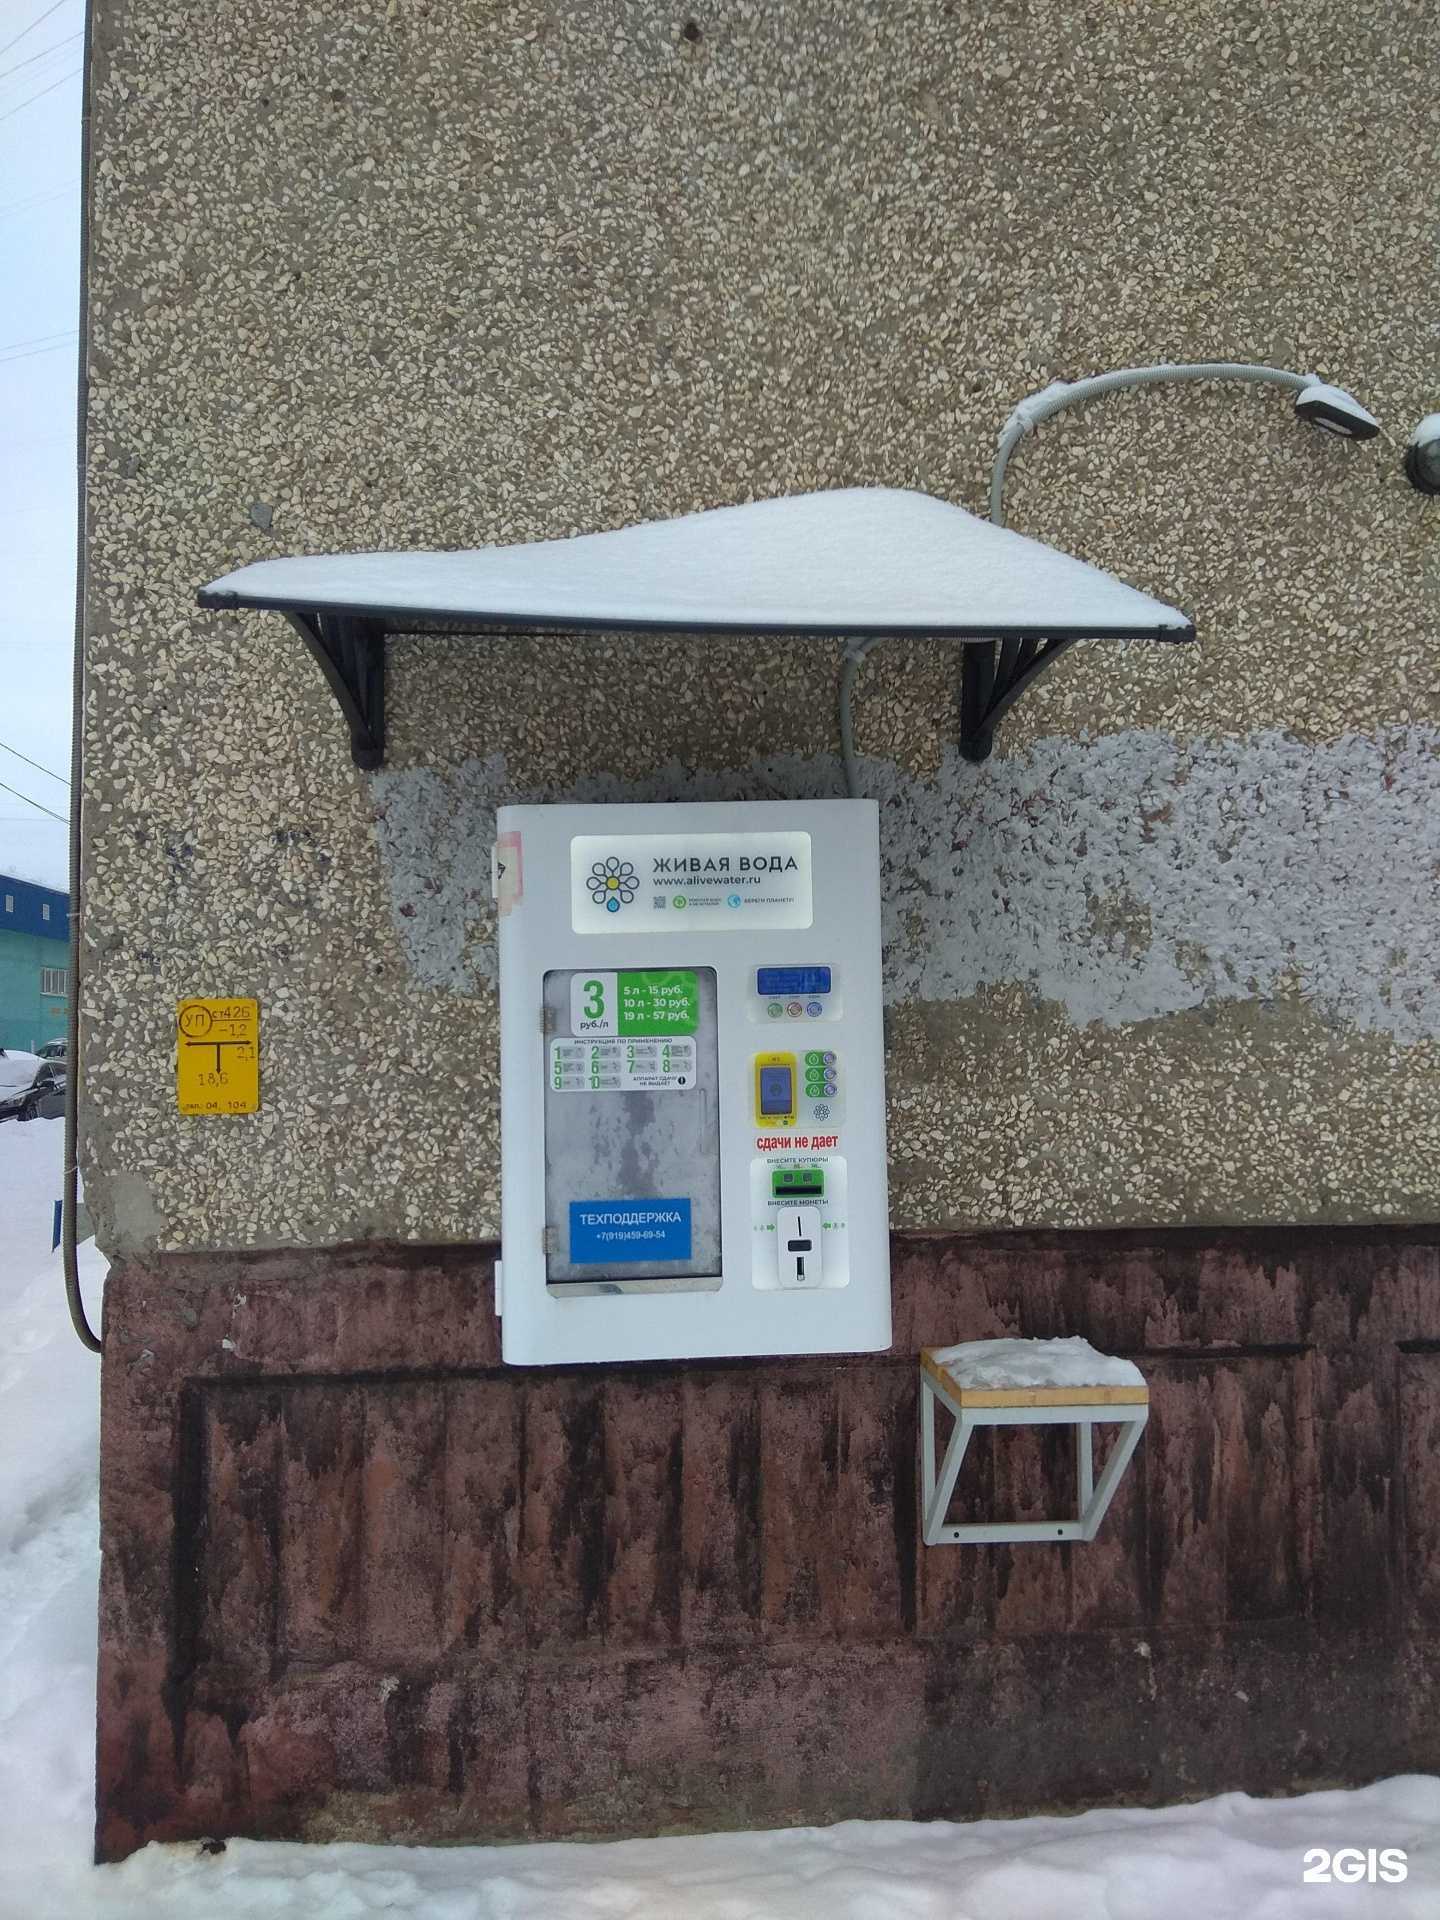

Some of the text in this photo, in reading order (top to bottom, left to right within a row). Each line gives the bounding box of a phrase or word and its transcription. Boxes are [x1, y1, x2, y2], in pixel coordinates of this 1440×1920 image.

[653, 856, 799, 873] ЖИВАЯ ВОДА
[653, 875, 761, 886] www.alivewater.ru
[623, 986, 631, 995] 5
[631, 987, 640, 995] л
[648, 985, 659, 994] 15
[661, 984, 683, 996] руб.
[584, 980, 605, 1019] 3
[623, 998, 635, 1008] 10
[636, 999, 645, 1008] л
[653, 998, 667, 1007] 30
[668, 997, 691, 1009] руб.
[185, 1014, 205, 1028] УП
[623, 1011, 635, 1021] 19
[636, 1012, 645, 1021] л
[653, 1011, 666, 1020] 57
[667, 1010, 690, 1022] руб.
[580, 1019, 609, 1030] руб./л
[591, 1046, 600, 1060] 2
[626, 1045, 635, 1059] 3
[662, 1045, 672, 1059] 4
[554, 1061, 562, 1075] 5
[592, 1060, 600, 1074] 6
[626, 1059, 635, 1073] 7
[662, 1059, 671, 1073] 8
[554, 1075, 562, 1089] 9
[756, 1134, 839, 1151] сдачи не дает
[579, 1211, 682, 1226] ТЕХПОДДЕРЖКА
